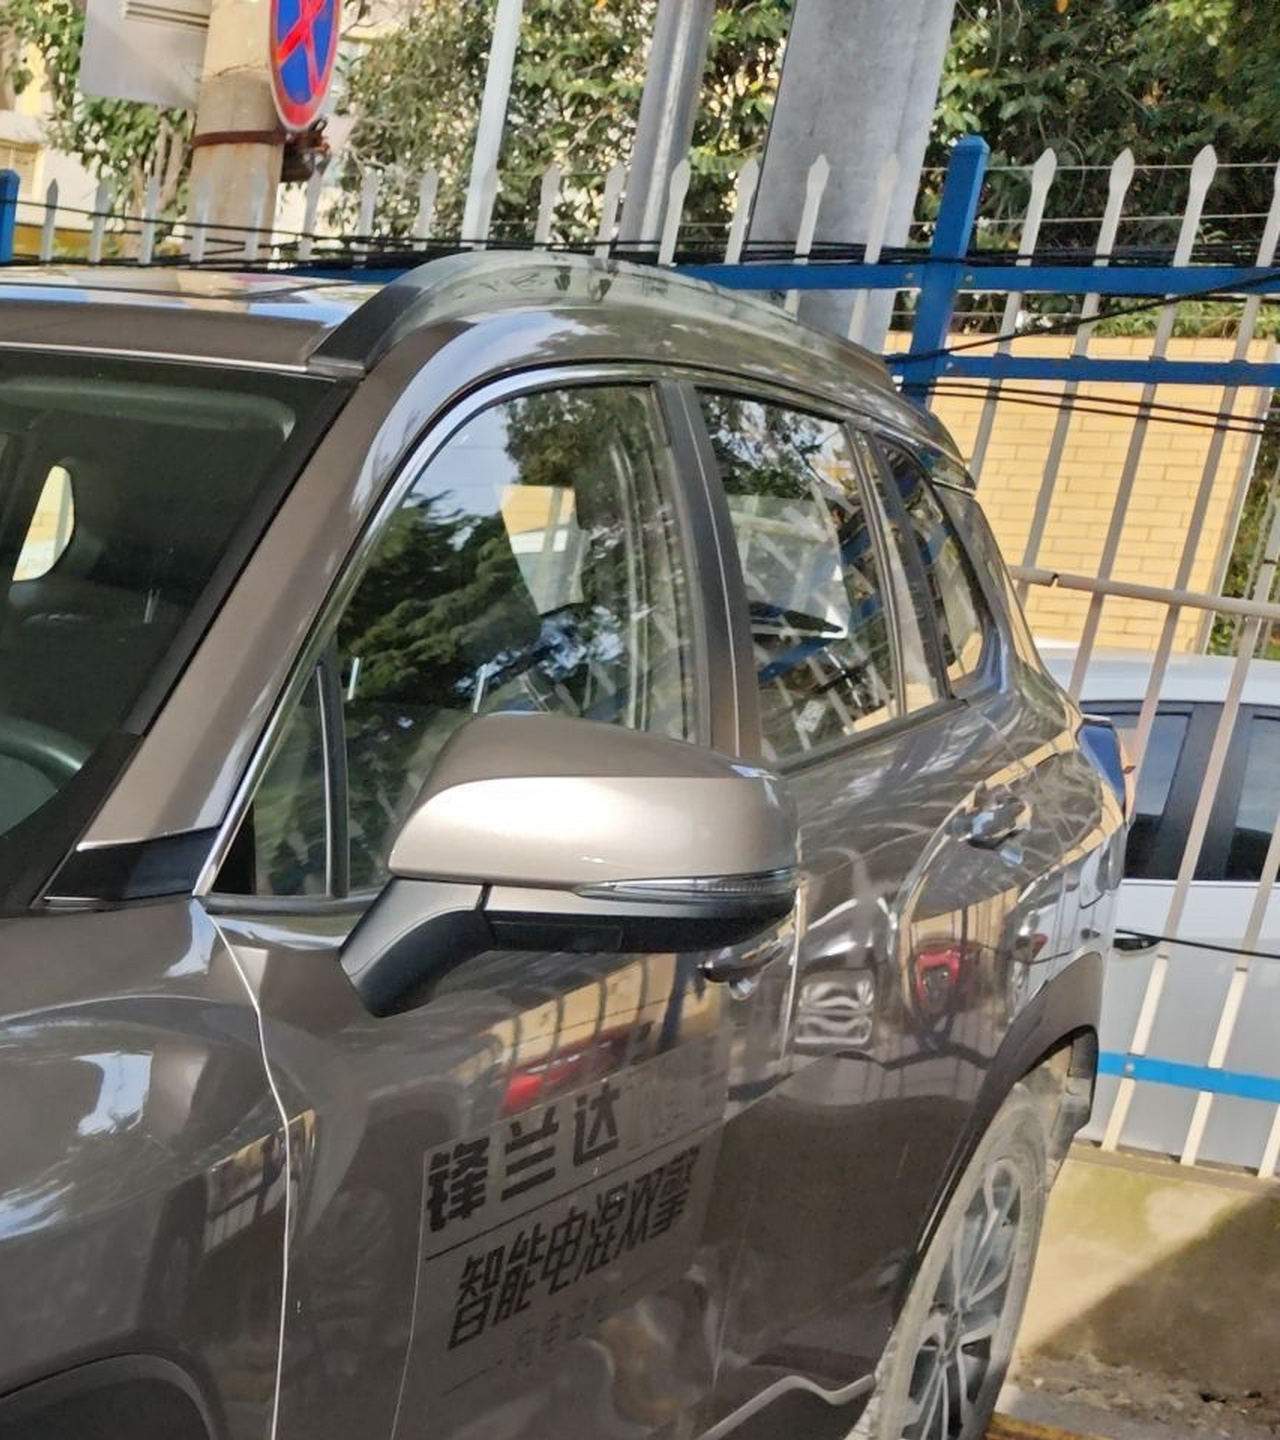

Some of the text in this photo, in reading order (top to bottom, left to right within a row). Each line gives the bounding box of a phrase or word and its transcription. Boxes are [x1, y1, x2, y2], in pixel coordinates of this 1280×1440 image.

[426, 1081, 622, 1233] 锋兰达
[447, 1144, 702, 1351] 智能电混双擎
